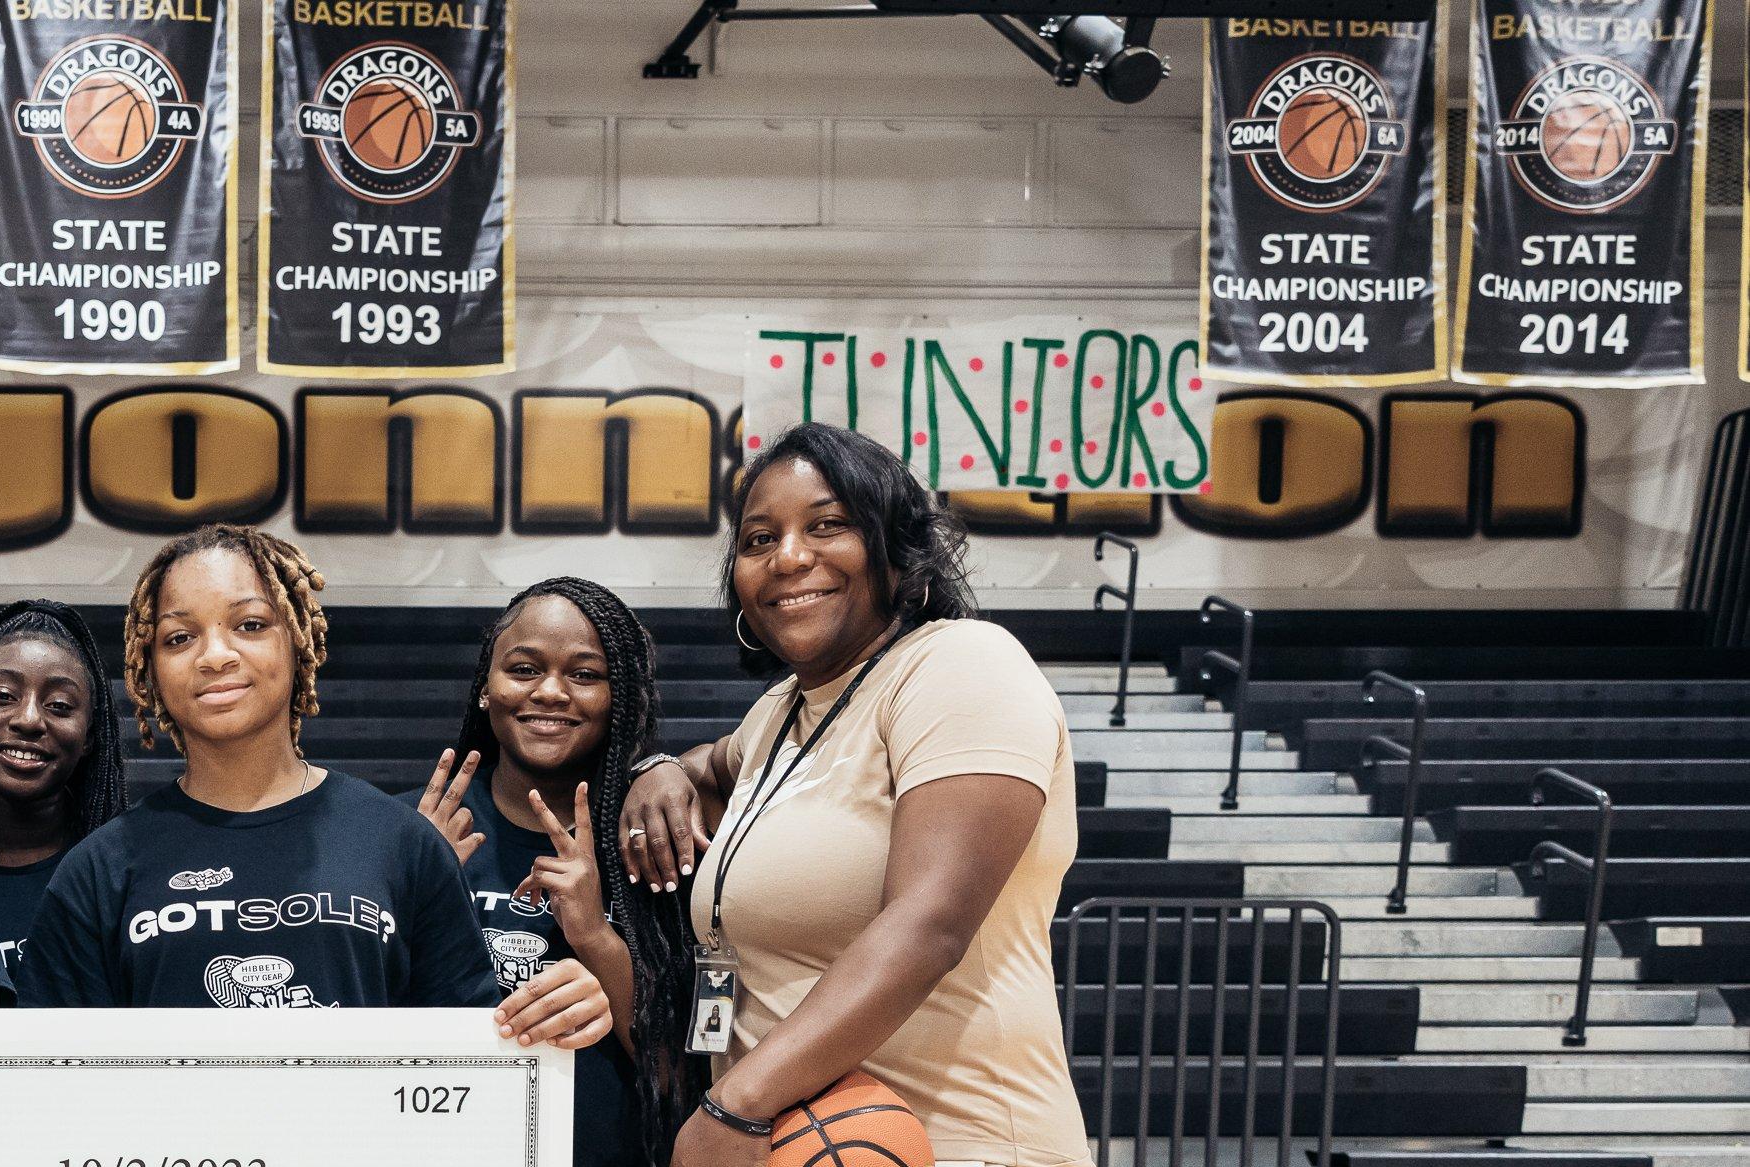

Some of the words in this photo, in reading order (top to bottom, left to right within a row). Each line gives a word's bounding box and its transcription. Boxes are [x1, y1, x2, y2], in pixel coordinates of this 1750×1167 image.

[293, 0, 490, 32] BASKETBALL
[1492, 13, 1693, 42] BASKETBALL
[46, 44, 174, 98] DRAGONS
[327, 51, 451, 105] DRAGONS
[1263, 62, 1384, 114] DRAGONS
[1527, 65, 1649, 117] DRAGONS
[20, 109, 61, 130] 1990
[167, 112, 193, 131] 4A
[302, 111, 341, 133] 1993
[444, 119, 469, 139] 5A
[1231, 126, 1276, 146] 2004
[1377, 127, 1398, 147] 6A
[1495, 127, 1540, 147] 2014
[1643, 127, 1668, 147] 5A
[52, 219, 167, 253] STATE
[331, 222, 443, 257] STATE
[1259, 234, 1371, 267] STATE
[1520, 234, 1637, 267] STATE
[275, 265, 498, 295] CHAMPIONSHIP
[1212, 273, 1427, 303] CHAMPIONSHIP
[1477, 272, 1684, 305] CHAMPIONSHIP
[53, 298, 167, 342] 1990
[331, 301, 441, 346] 1993
[1258, 312, 1370, 355] 2004
[1519, 313, 1630, 356] 2014
[501, 938, 538, 946] HIBBETT
[241, 963, 282, 972] HIBBETT
[242, 975, 260, 983] CITY
[262, 973, 283, 981] GEAR
[394, 1086, 470, 1114] 1027
